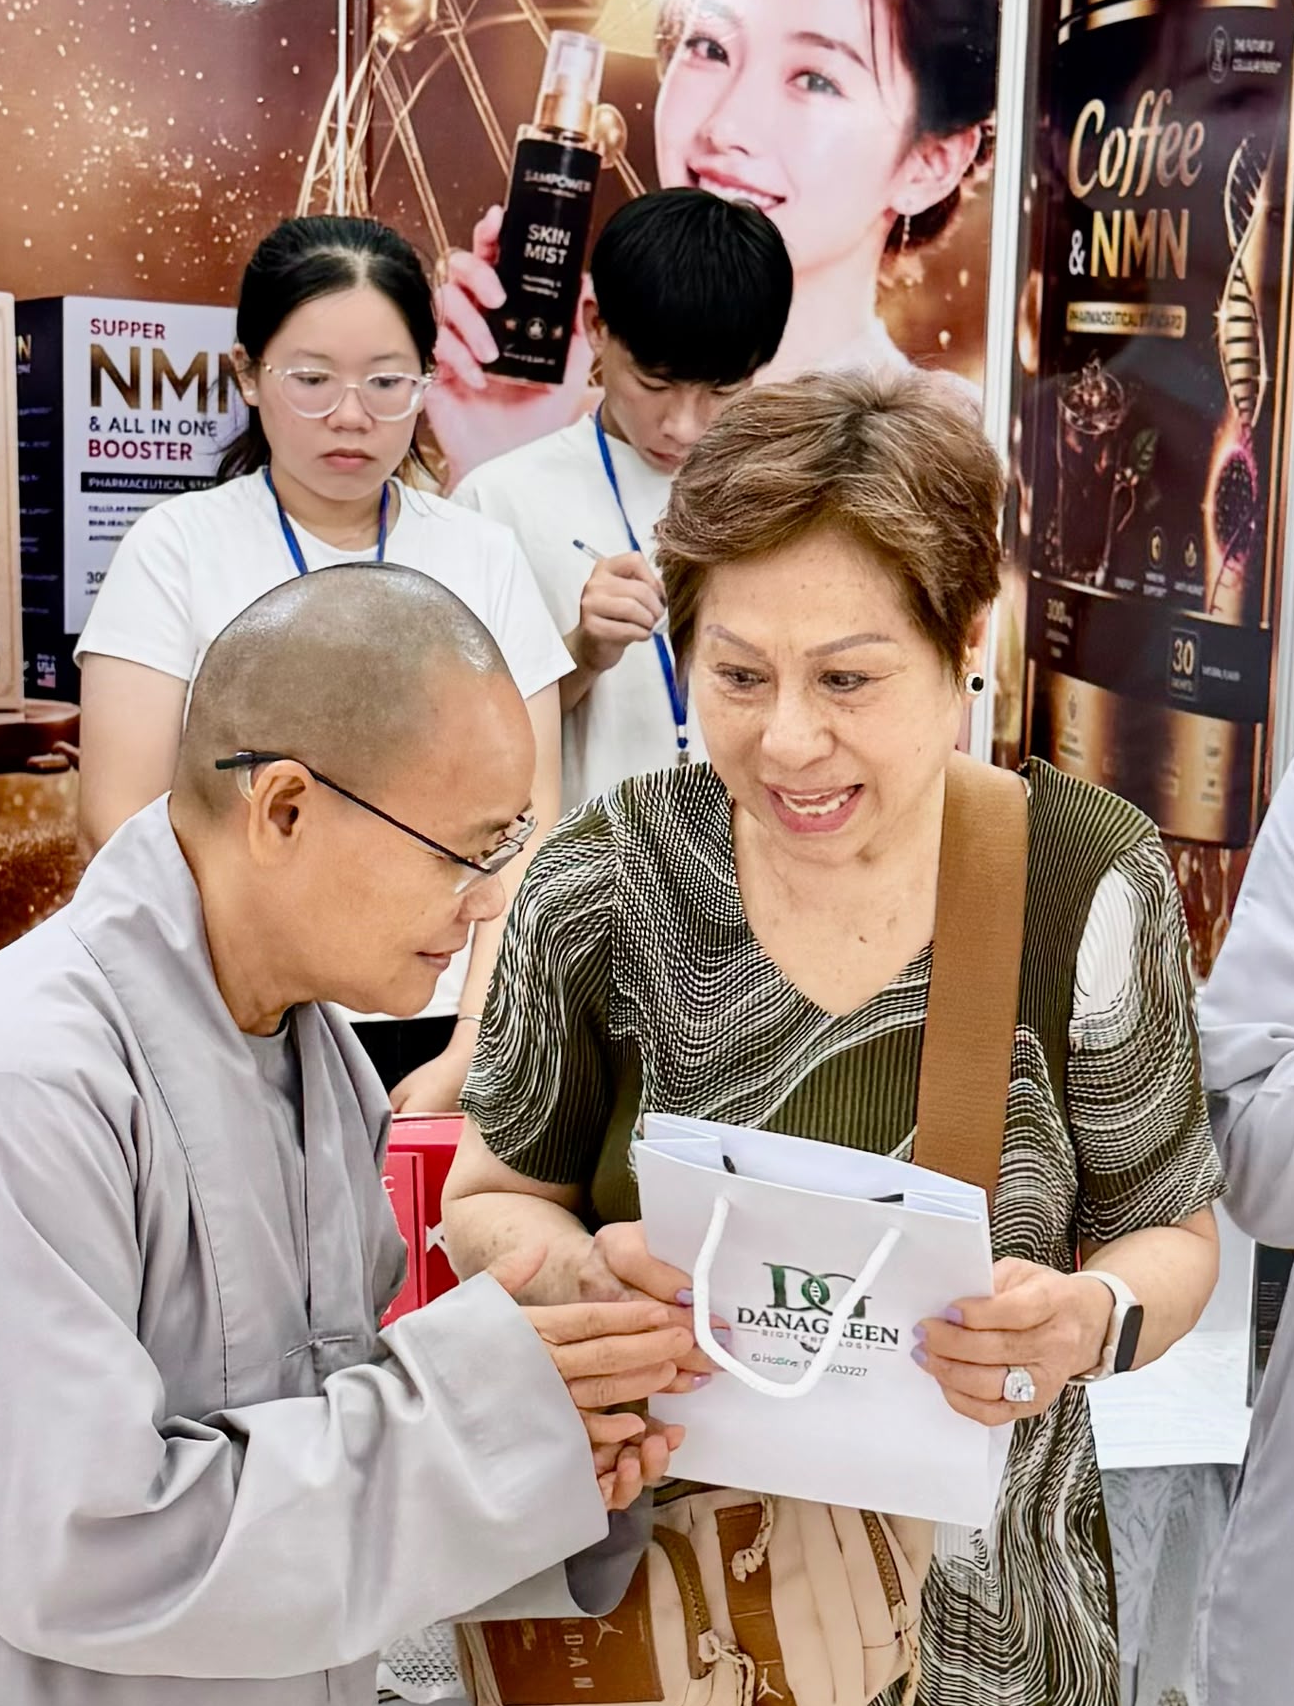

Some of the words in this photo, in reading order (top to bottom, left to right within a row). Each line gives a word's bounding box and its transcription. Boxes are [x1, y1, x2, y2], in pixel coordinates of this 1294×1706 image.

[1068, 89, 1205, 199] Coffee
[527, 223, 571, 246] SKIN
[1068, 229, 1086, 276] &
[1090, 208, 1190, 280] NMN
[524, 242, 568, 265] MIST
[90, 318, 166, 340] SUPPER
[89, 416, 101, 432] &
[109, 416, 144, 434] ALL
[152, 419, 171, 435] IN
[178, 419, 218, 438] ONE
[88, 438, 192, 462] BOOSTER
[88, 477, 185, 490] PHARMACEUTICAL
[1172, 638, 1195, 675] 30
[737, 1306, 899, 1345] DANAGEEN
